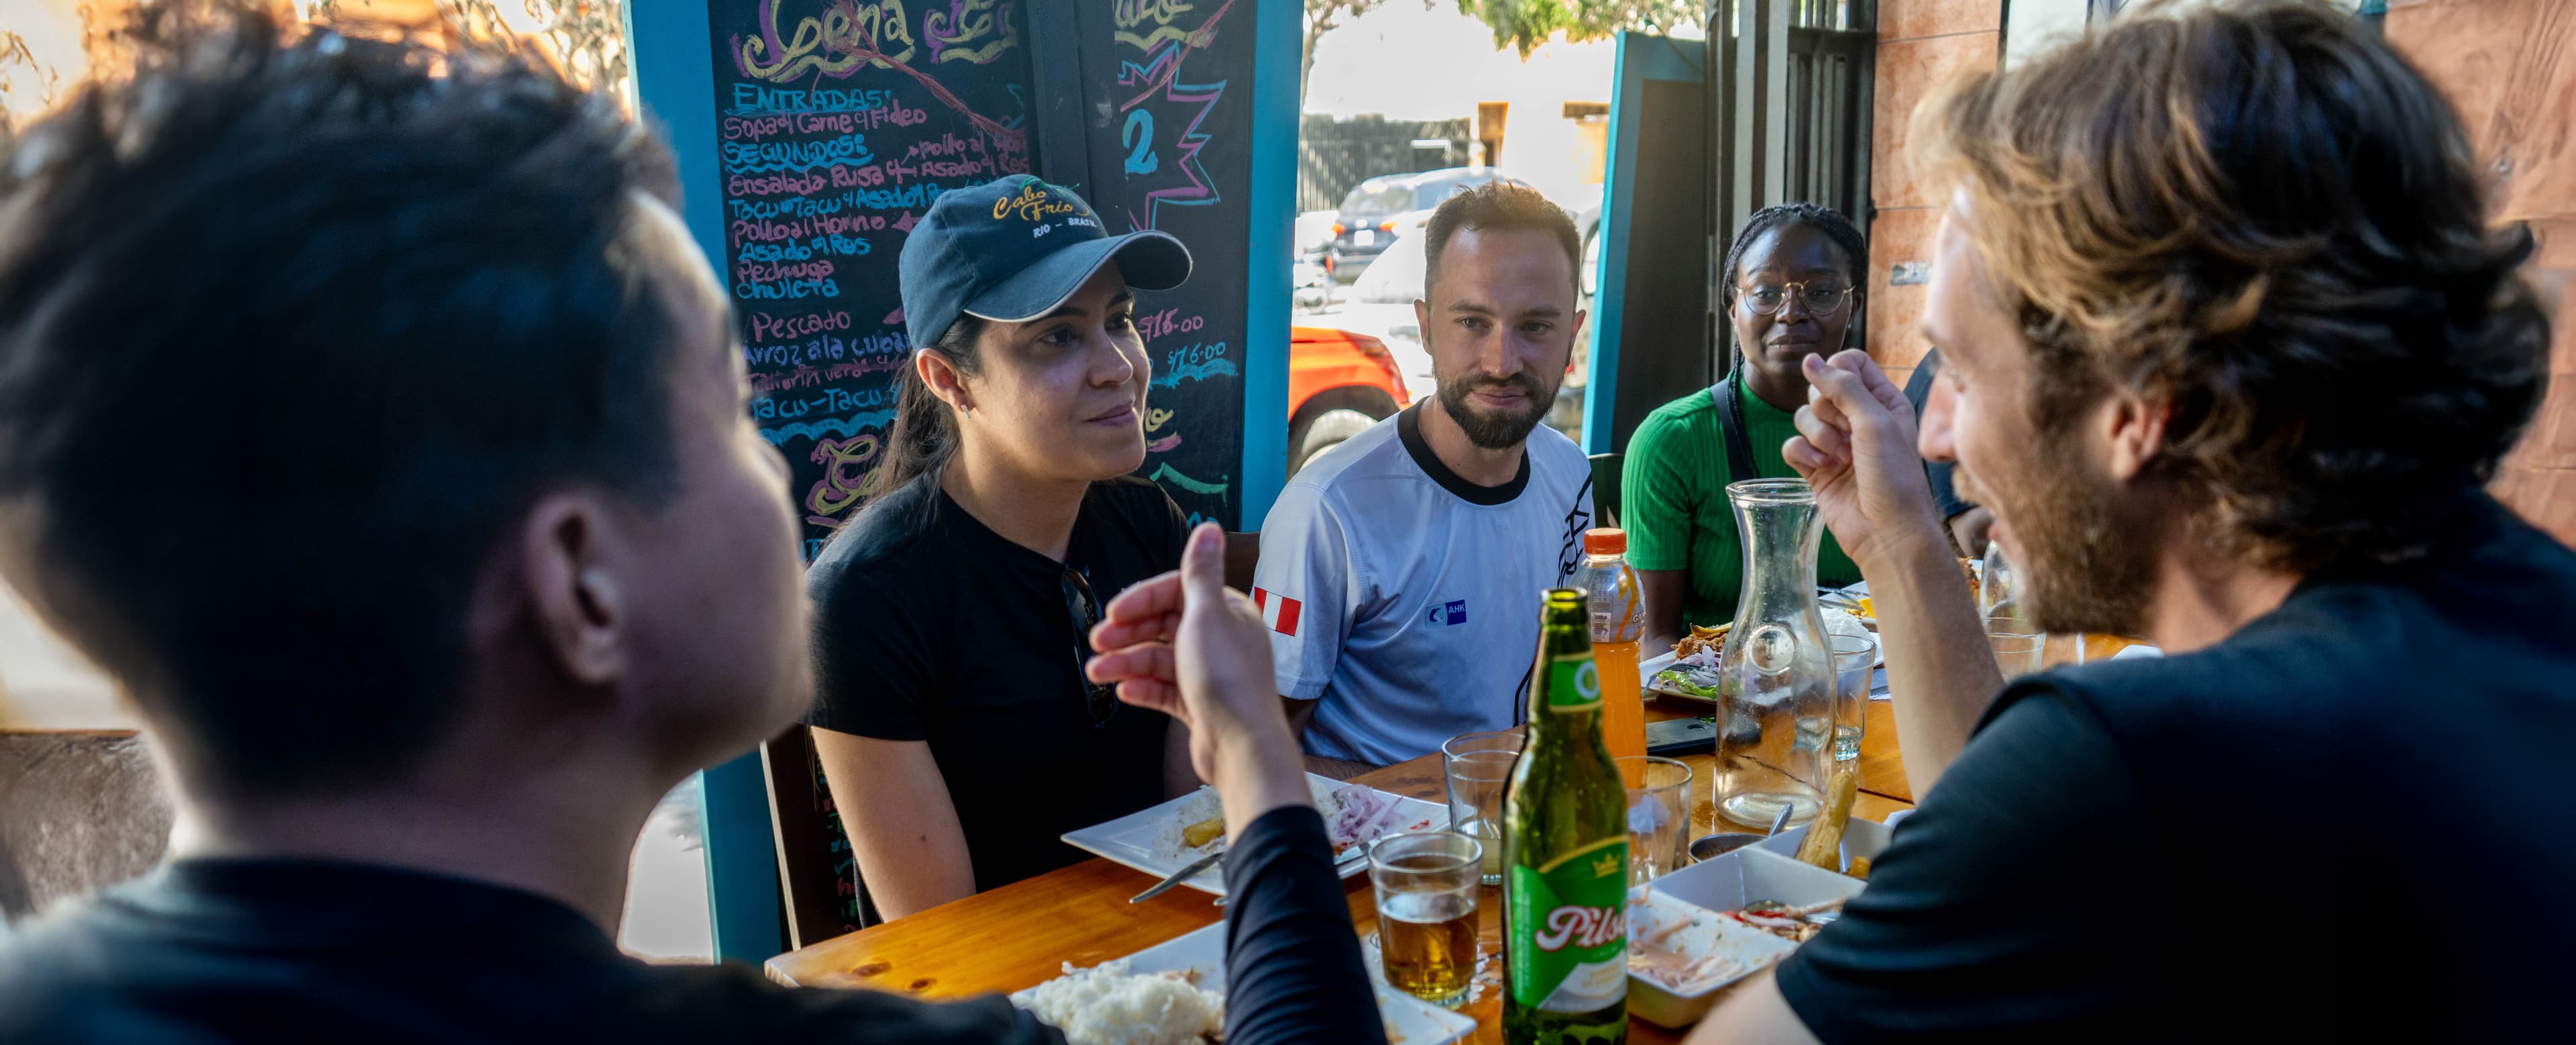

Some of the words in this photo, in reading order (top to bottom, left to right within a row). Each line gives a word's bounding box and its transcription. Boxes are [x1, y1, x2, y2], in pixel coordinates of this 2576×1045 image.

[724, 117, 777, 142] Sopa
[797, 113, 854, 133] Carne
[994, 186, 1046, 219] Cabo
[1033, 224, 1051, 238] RIO
[1068, 217, 1097, 228] BRASIL
[739, 237, 812, 262] Asado
[737, 260, 835, 284] Pechuga
[753, 309, 851, 343] Pescado
[1448, 603, 1466, 614] AHK
